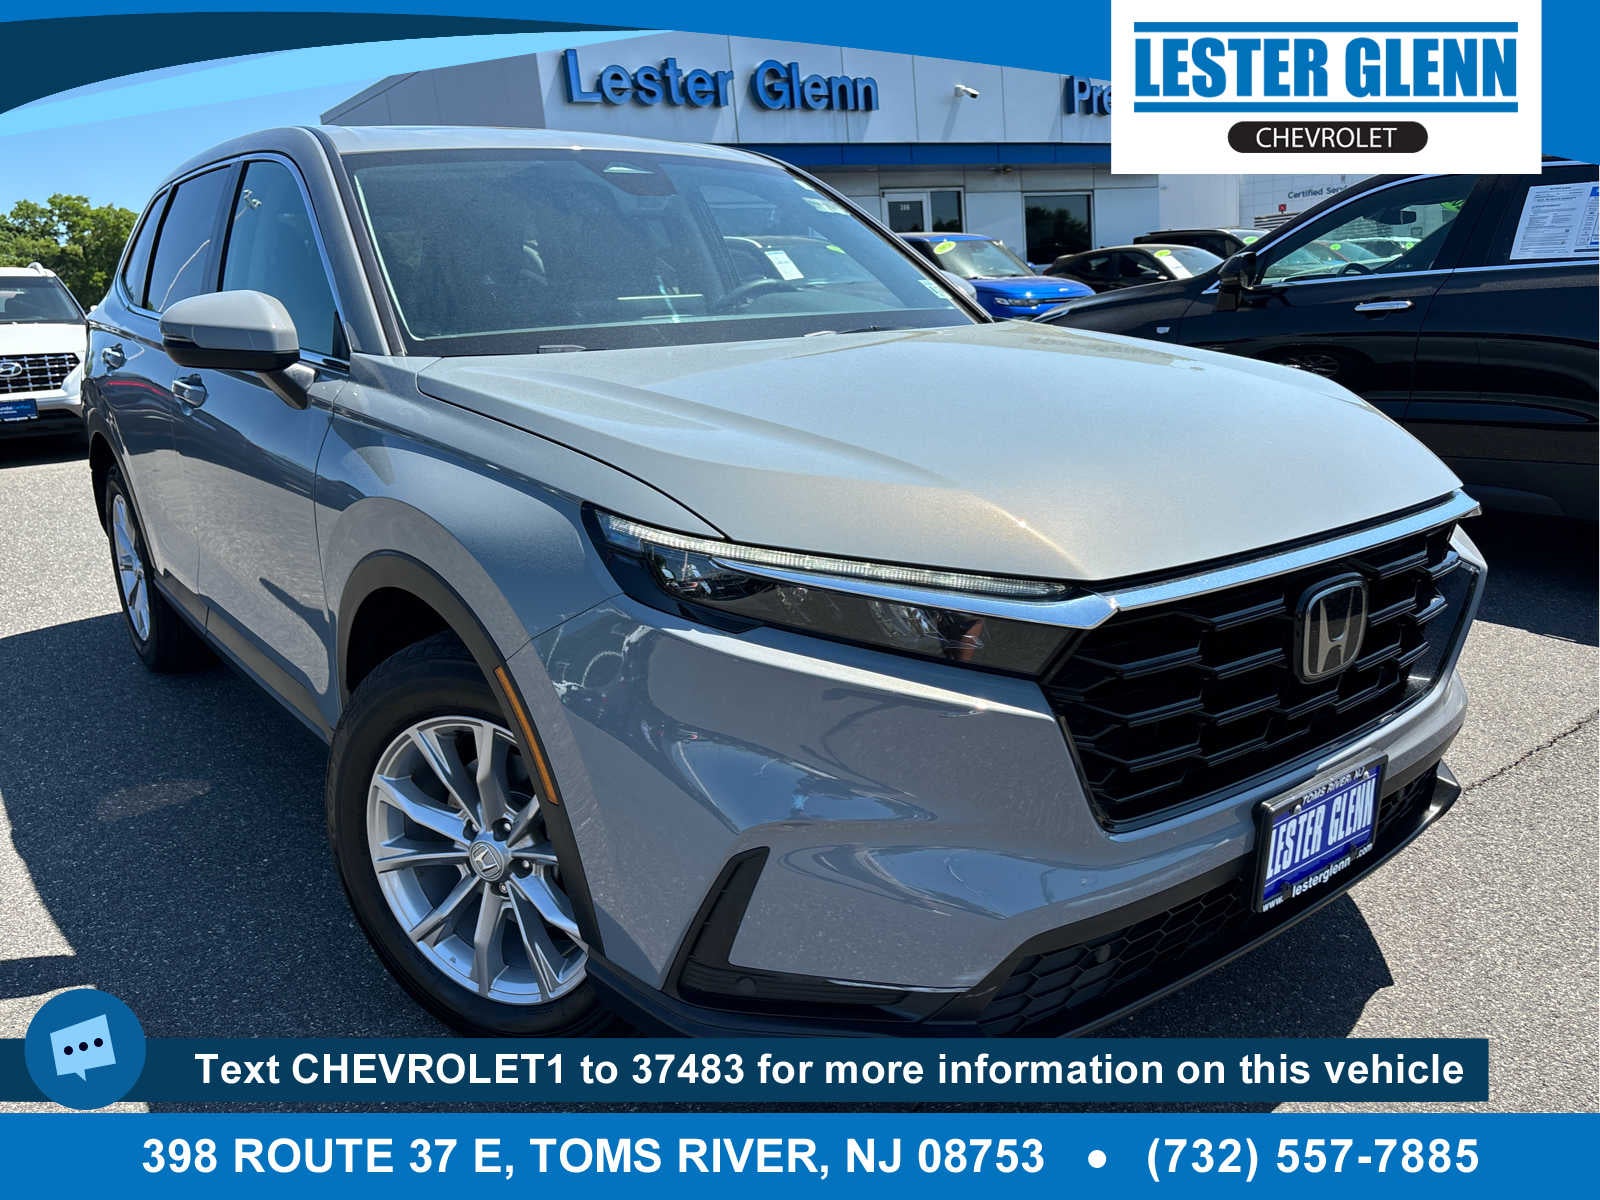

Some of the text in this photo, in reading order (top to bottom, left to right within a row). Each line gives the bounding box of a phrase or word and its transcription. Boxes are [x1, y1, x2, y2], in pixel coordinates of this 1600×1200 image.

[562, 48, 880, 112] Lester Glenn
[1287, 187, 1323, 200] Certified
[1266, 778, 1376, 880] LESTER GLENN
